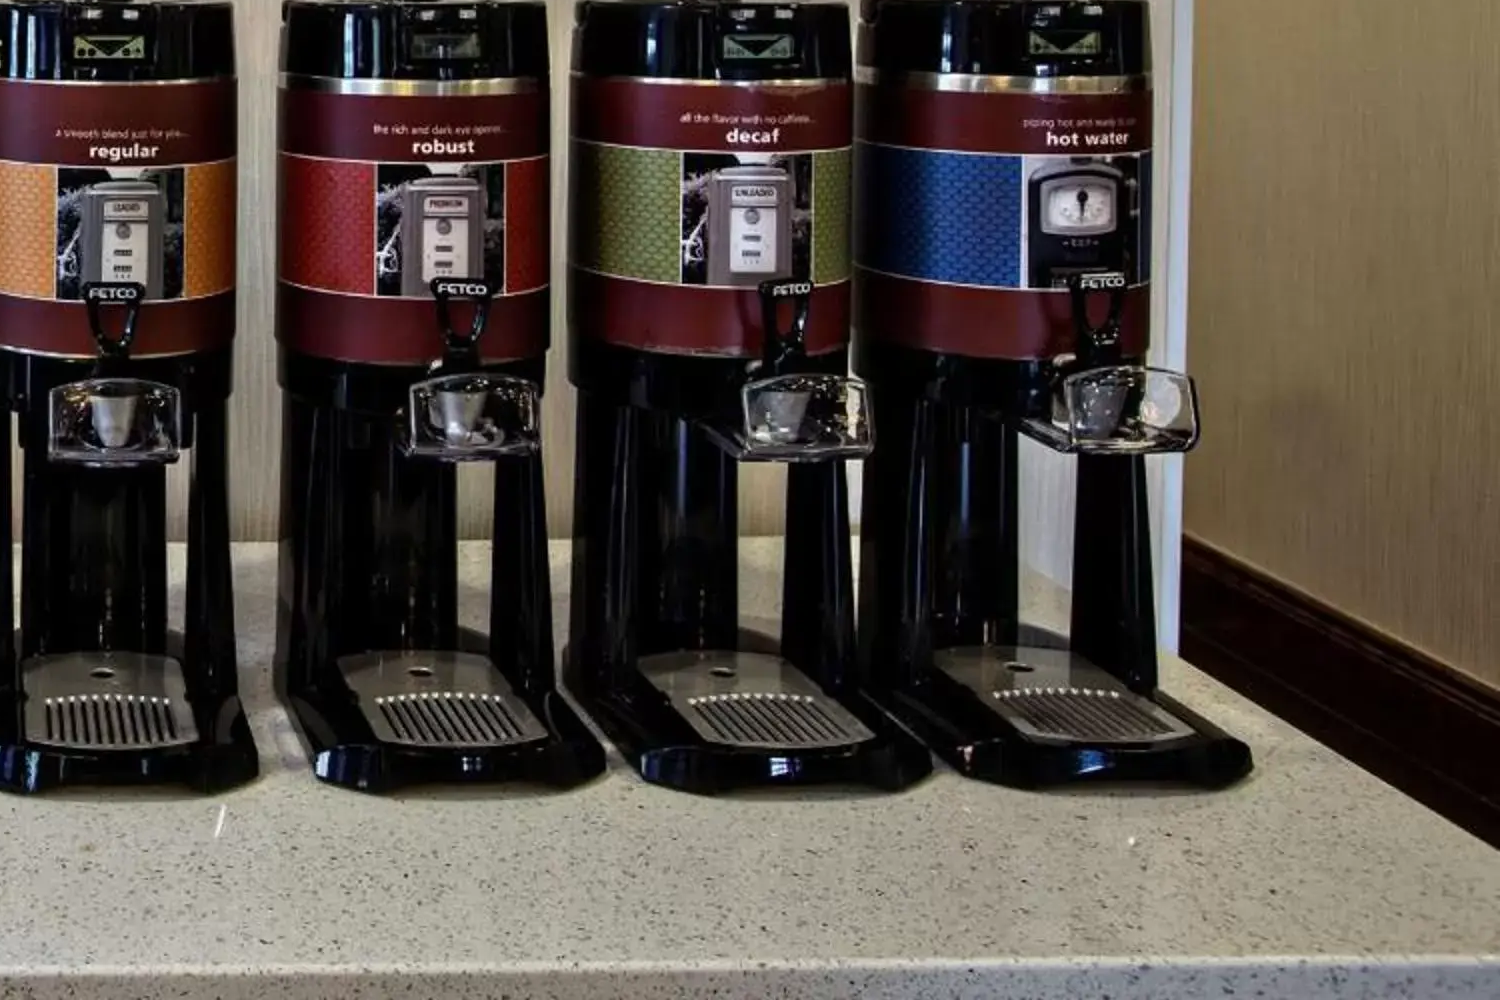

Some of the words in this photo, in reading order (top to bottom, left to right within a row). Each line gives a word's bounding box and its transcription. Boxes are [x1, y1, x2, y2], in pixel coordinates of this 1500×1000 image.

[101, 129, 129, 138] blend
[391, 124, 409, 135] rich
[411, 125, 429, 135] and
[431, 125, 452, 135] dark
[725, 127, 780, 144] decaf
[1046, 131, 1079, 146] hot
[1084, 132, 1129, 146] water
[89, 143, 160, 161] regular
[412, 139, 475, 155] robust
[437, 283, 487, 295] FETCO
[772, 282, 811, 297] FETCO
[1080, 277, 1125, 289] FETCO
[89, 287, 137, 299] FETCO
